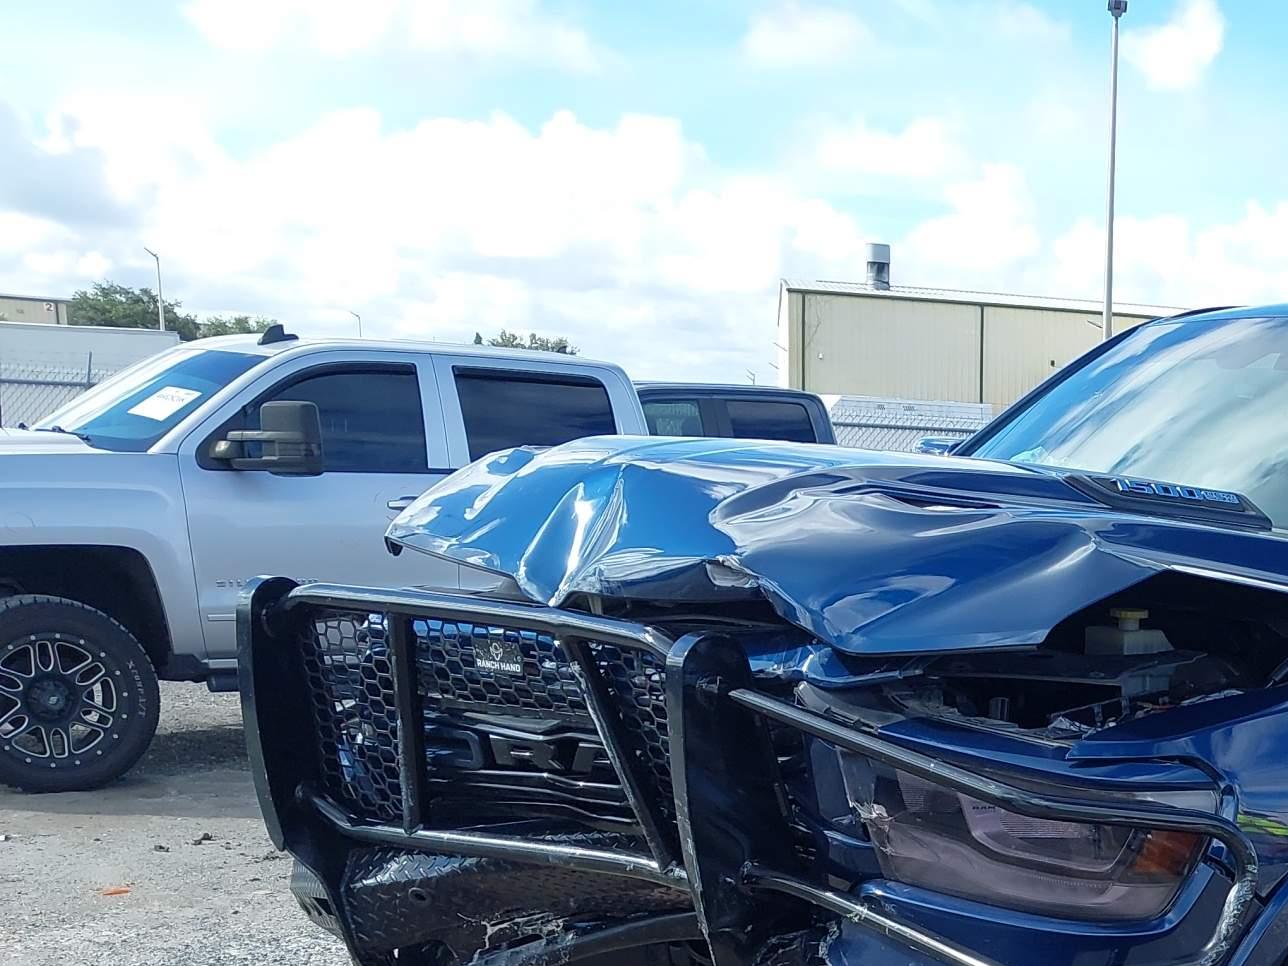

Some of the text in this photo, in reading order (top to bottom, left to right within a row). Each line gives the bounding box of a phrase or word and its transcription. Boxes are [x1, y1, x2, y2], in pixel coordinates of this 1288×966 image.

[1110, 478, 1202, 500] 1500
[476, 658, 521, 673] RANCH HAND
